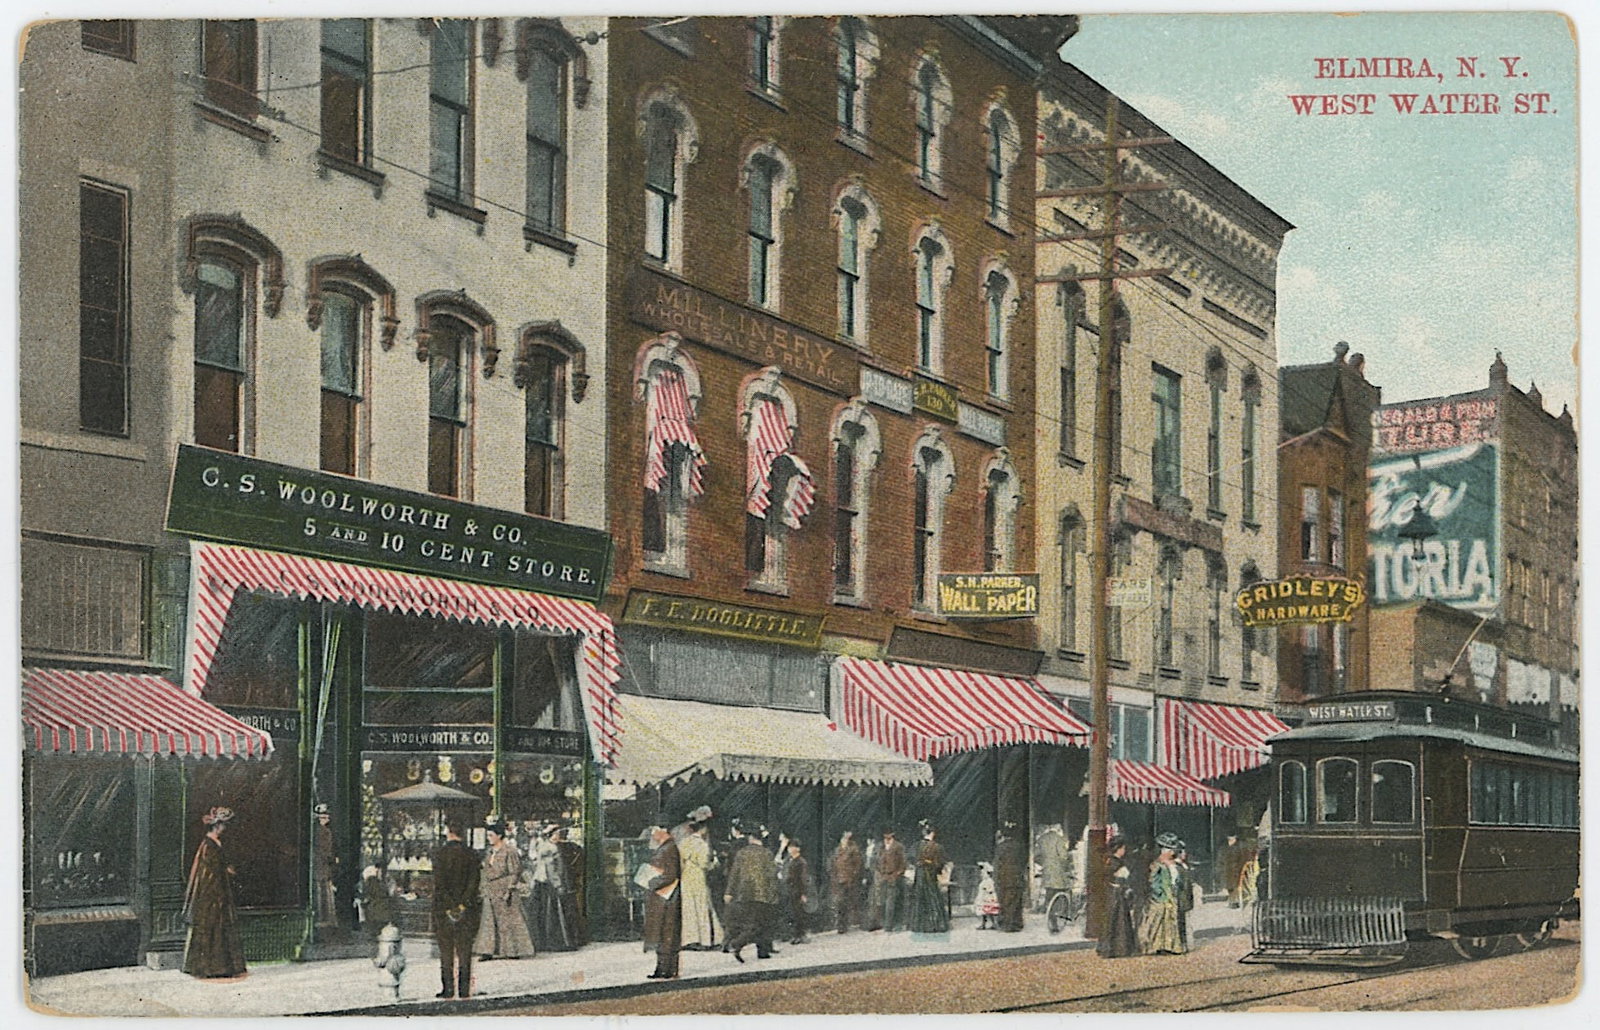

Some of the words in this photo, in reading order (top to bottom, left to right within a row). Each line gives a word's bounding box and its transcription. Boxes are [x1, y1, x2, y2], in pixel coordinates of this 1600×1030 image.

[643, 301, 758, 353] WHOLESALE
[657, 284, 834, 363] MILLINERY
[202, 466, 230, 488] C.
[239, 474, 265, 495] S.
[278, 480, 450, 530] WOOLWORTH
[464, 519, 479, 536] &
[493, 524, 527, 546] CO.
[303, 517, 317, 536] 5
[330, 527, 369, 543] AND
[381, 532, 404, 552] 10
[421, 539, 494, 567] CENT
[508, 555, 596, 584] STORE.
[939, 581, 980, 611] WALL
[987, 585, 1037, 611] PAPER
[1237, 580, 1358, 608] GRIDLEY'S
[1256, 603, 1341, 620] HARDWARE
[1309, 705, 1336, 719] WEST
[474, 731, 493, 745] CO.
